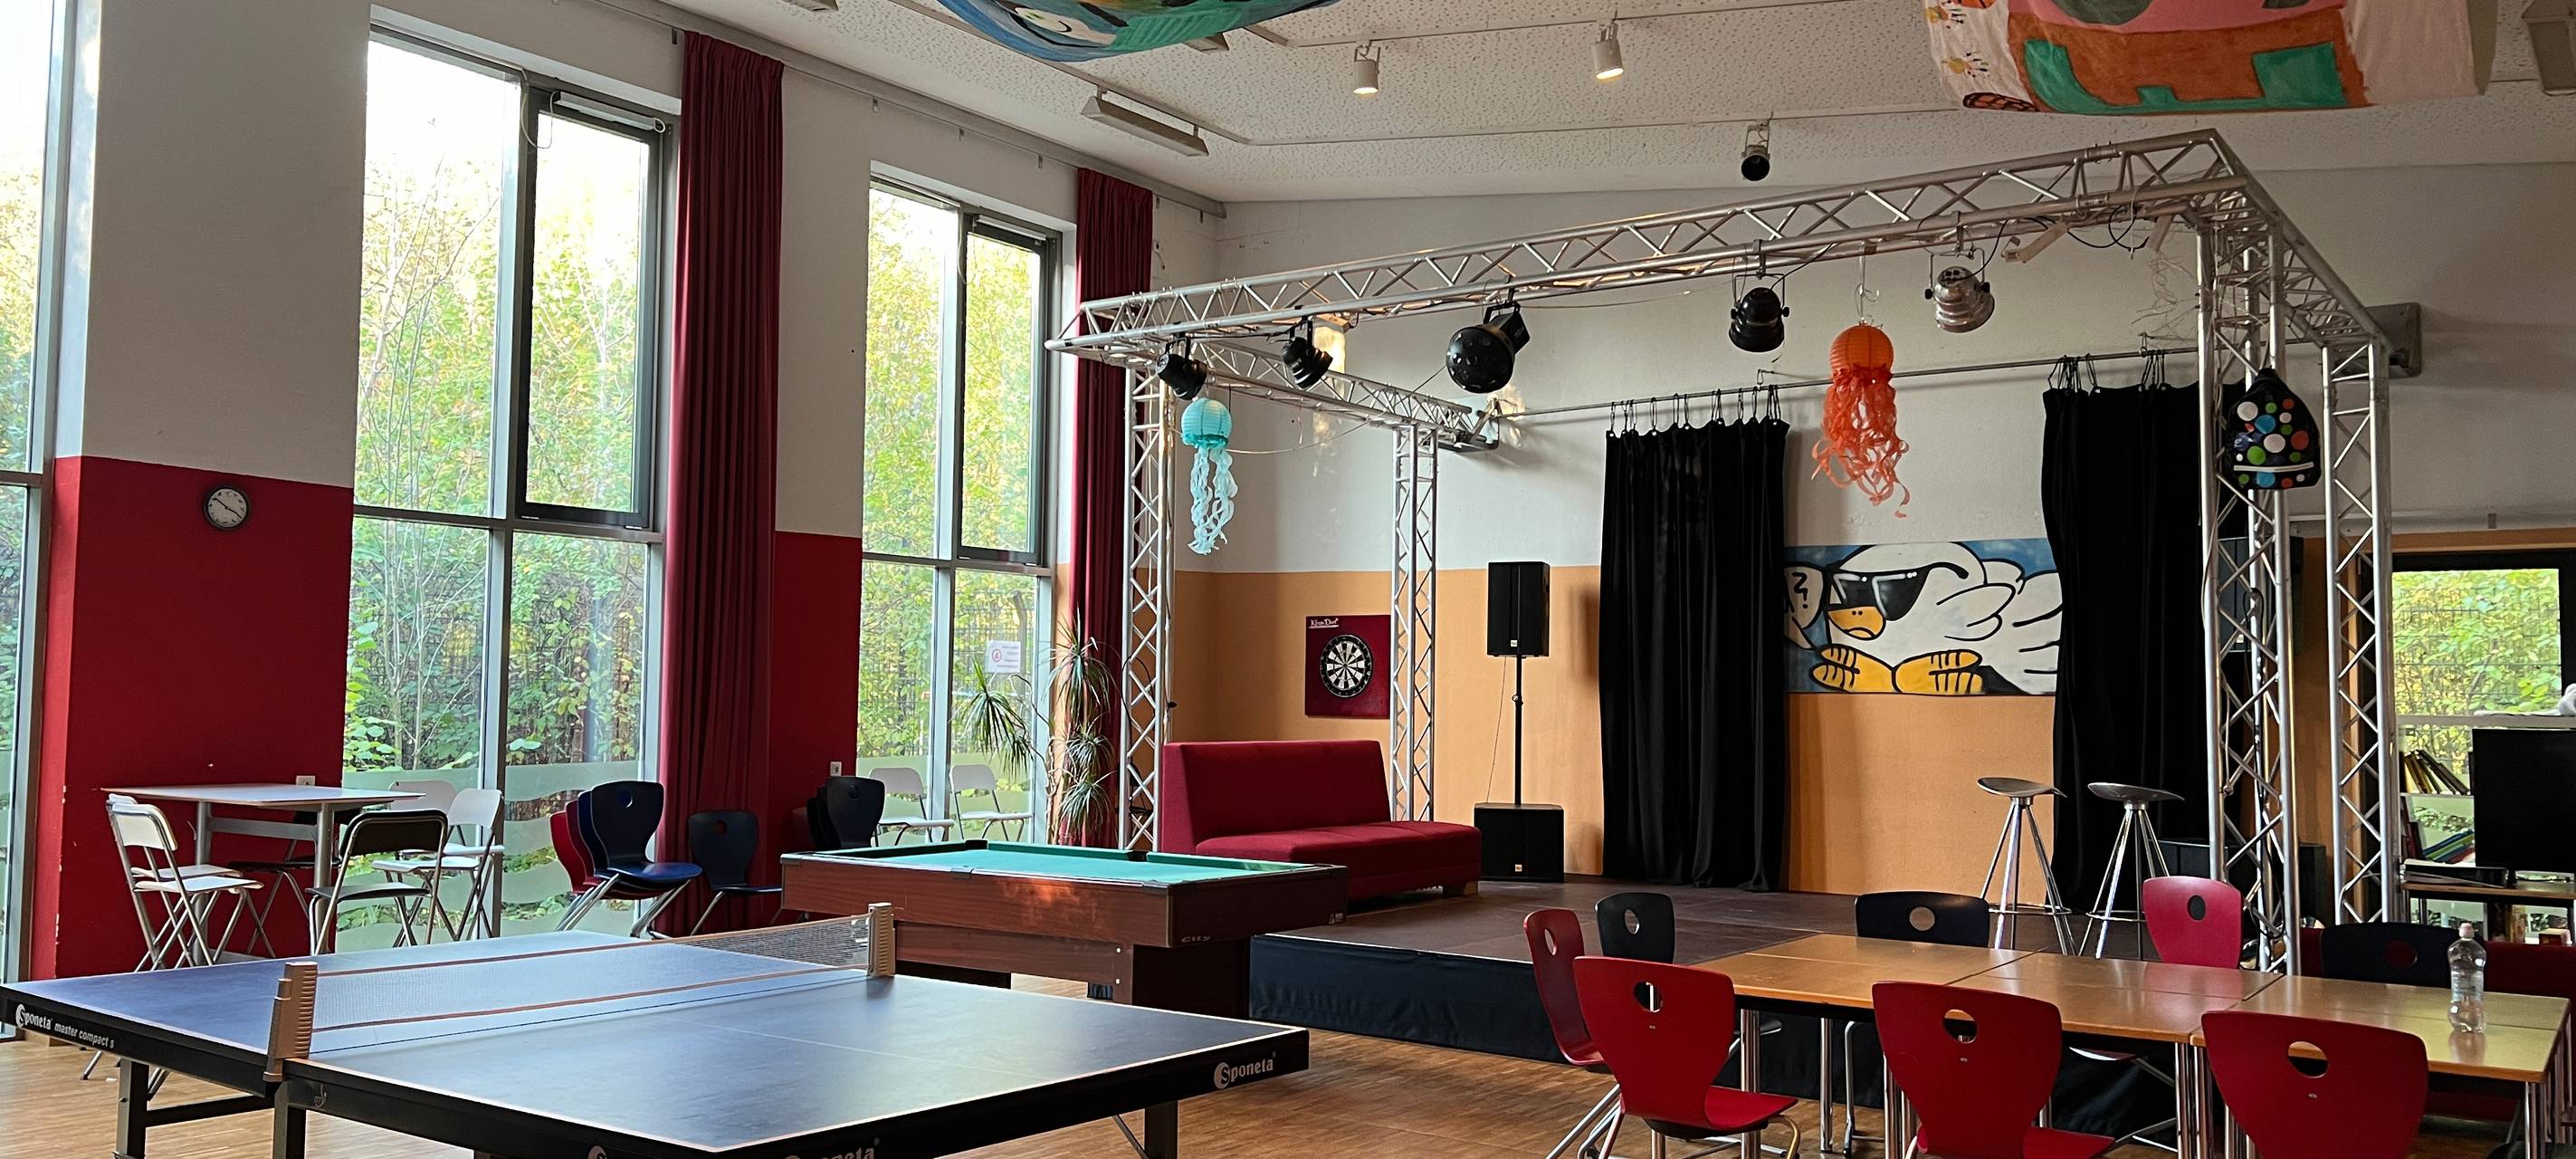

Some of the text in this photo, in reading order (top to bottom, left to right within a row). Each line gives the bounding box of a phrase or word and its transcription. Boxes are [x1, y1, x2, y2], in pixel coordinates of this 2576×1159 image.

[1792, 572, 1808, 608] ?
[15, 1003, 52, 1030] Sponeta
[54, 1022, 78, 1038] master
[79, 1030, 109, 1047] compact
[1214, 1058, 1274, 1089] Sponeta
